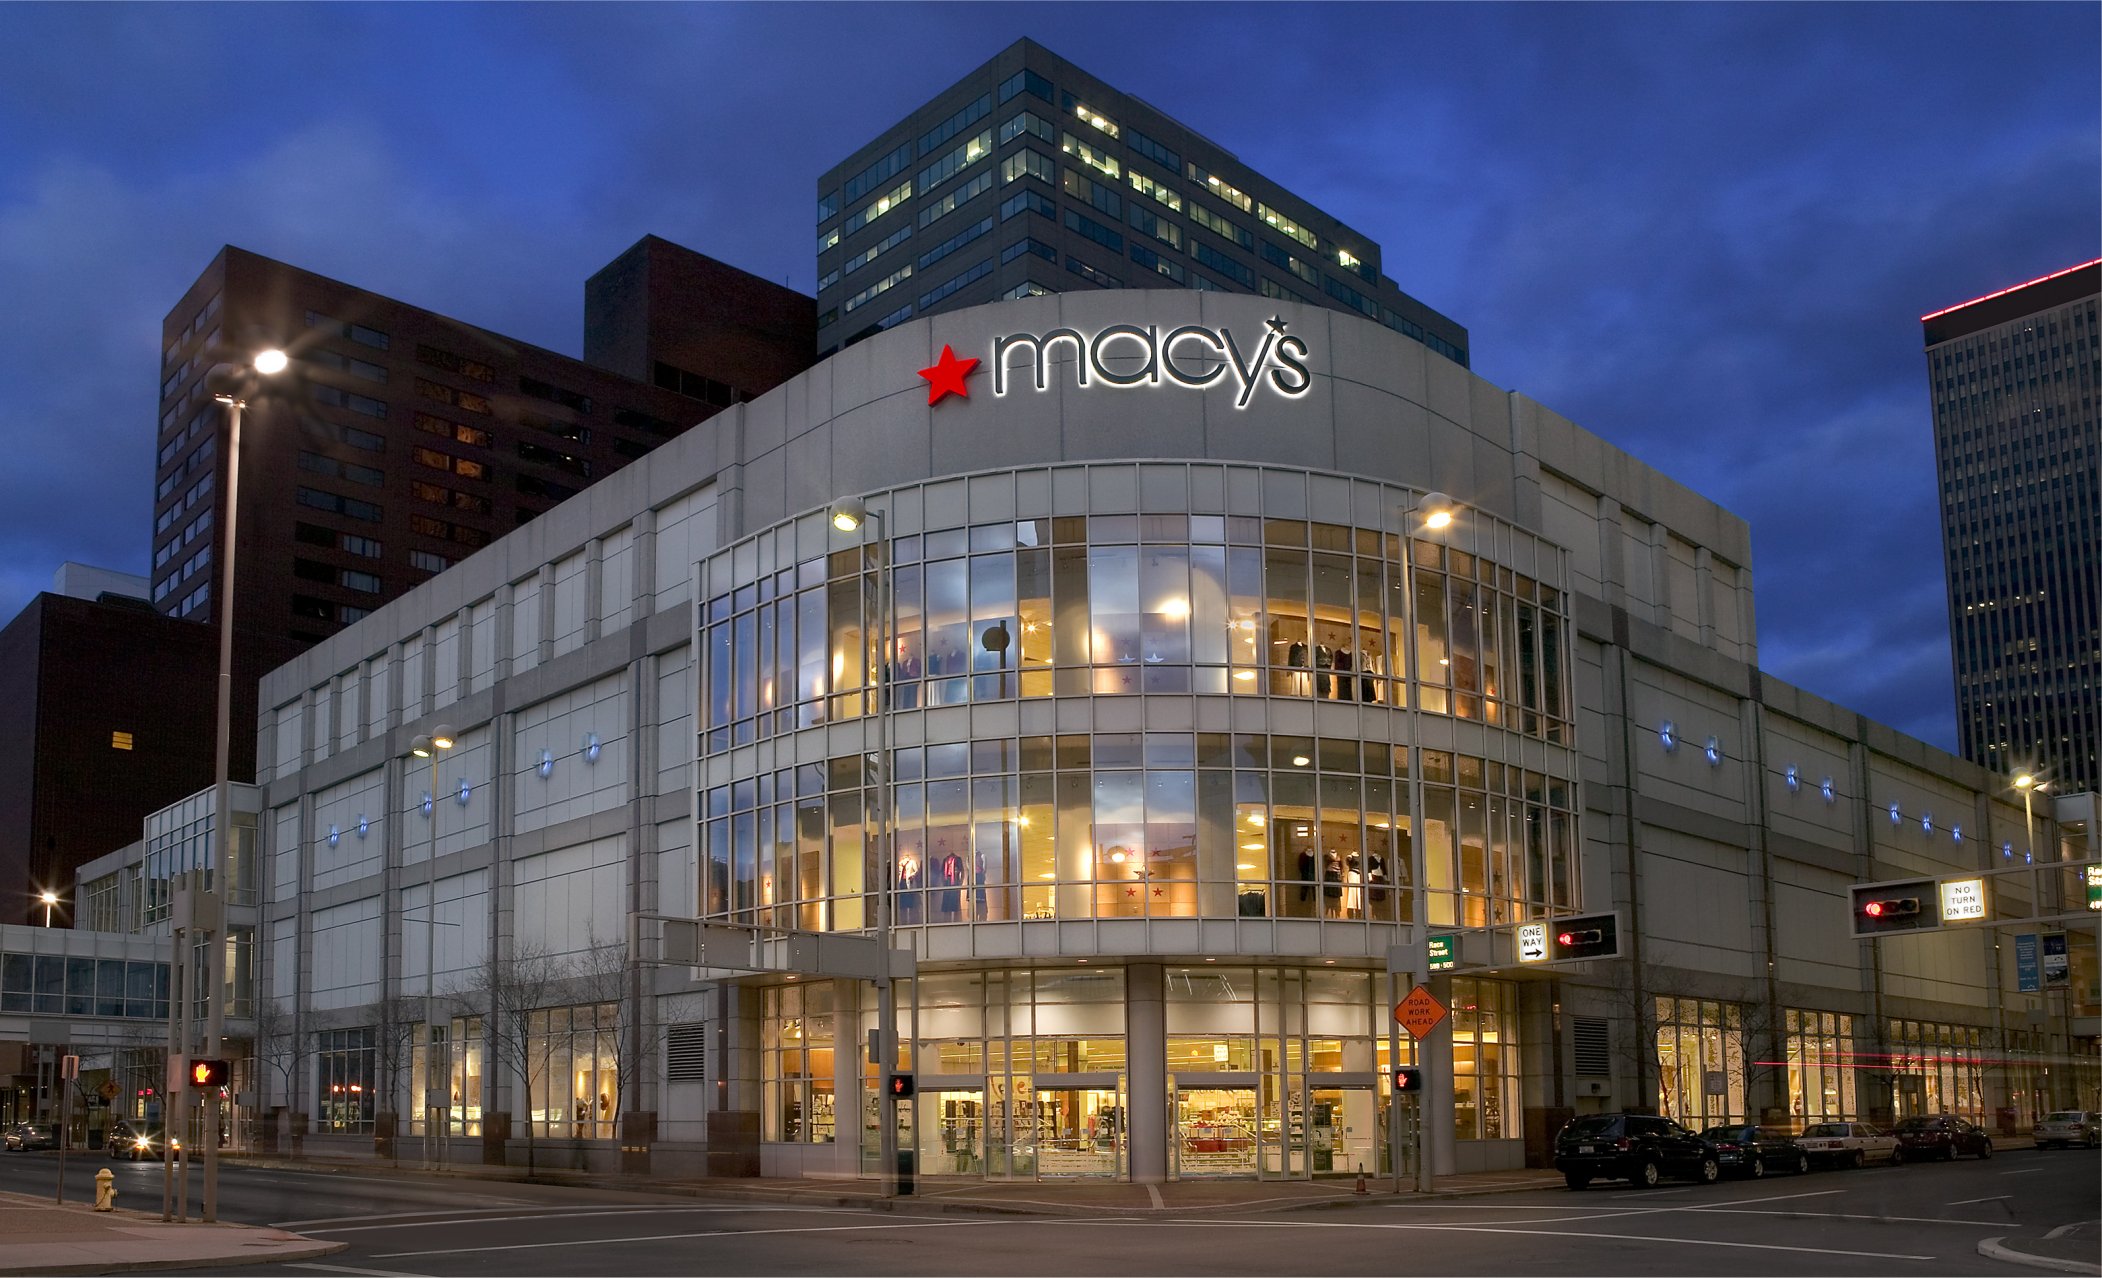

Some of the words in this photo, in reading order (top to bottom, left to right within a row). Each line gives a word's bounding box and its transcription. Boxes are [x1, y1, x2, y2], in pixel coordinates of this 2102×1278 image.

[994, 315, 1311, 407] macy's
[1955, 886, 1970, 894] NO
[1951, 896, 1976, 904] TURN
[1946, 907, 1959, 916] ON
[1963, 905, 1982, 914] RED
[1522, 927, 1541, 937] ONE
[1522, 937, 1542, 947] WAY
[1429, 949, 1448, 957] Street
[1408, 1008, 1430, 1016] WORK
